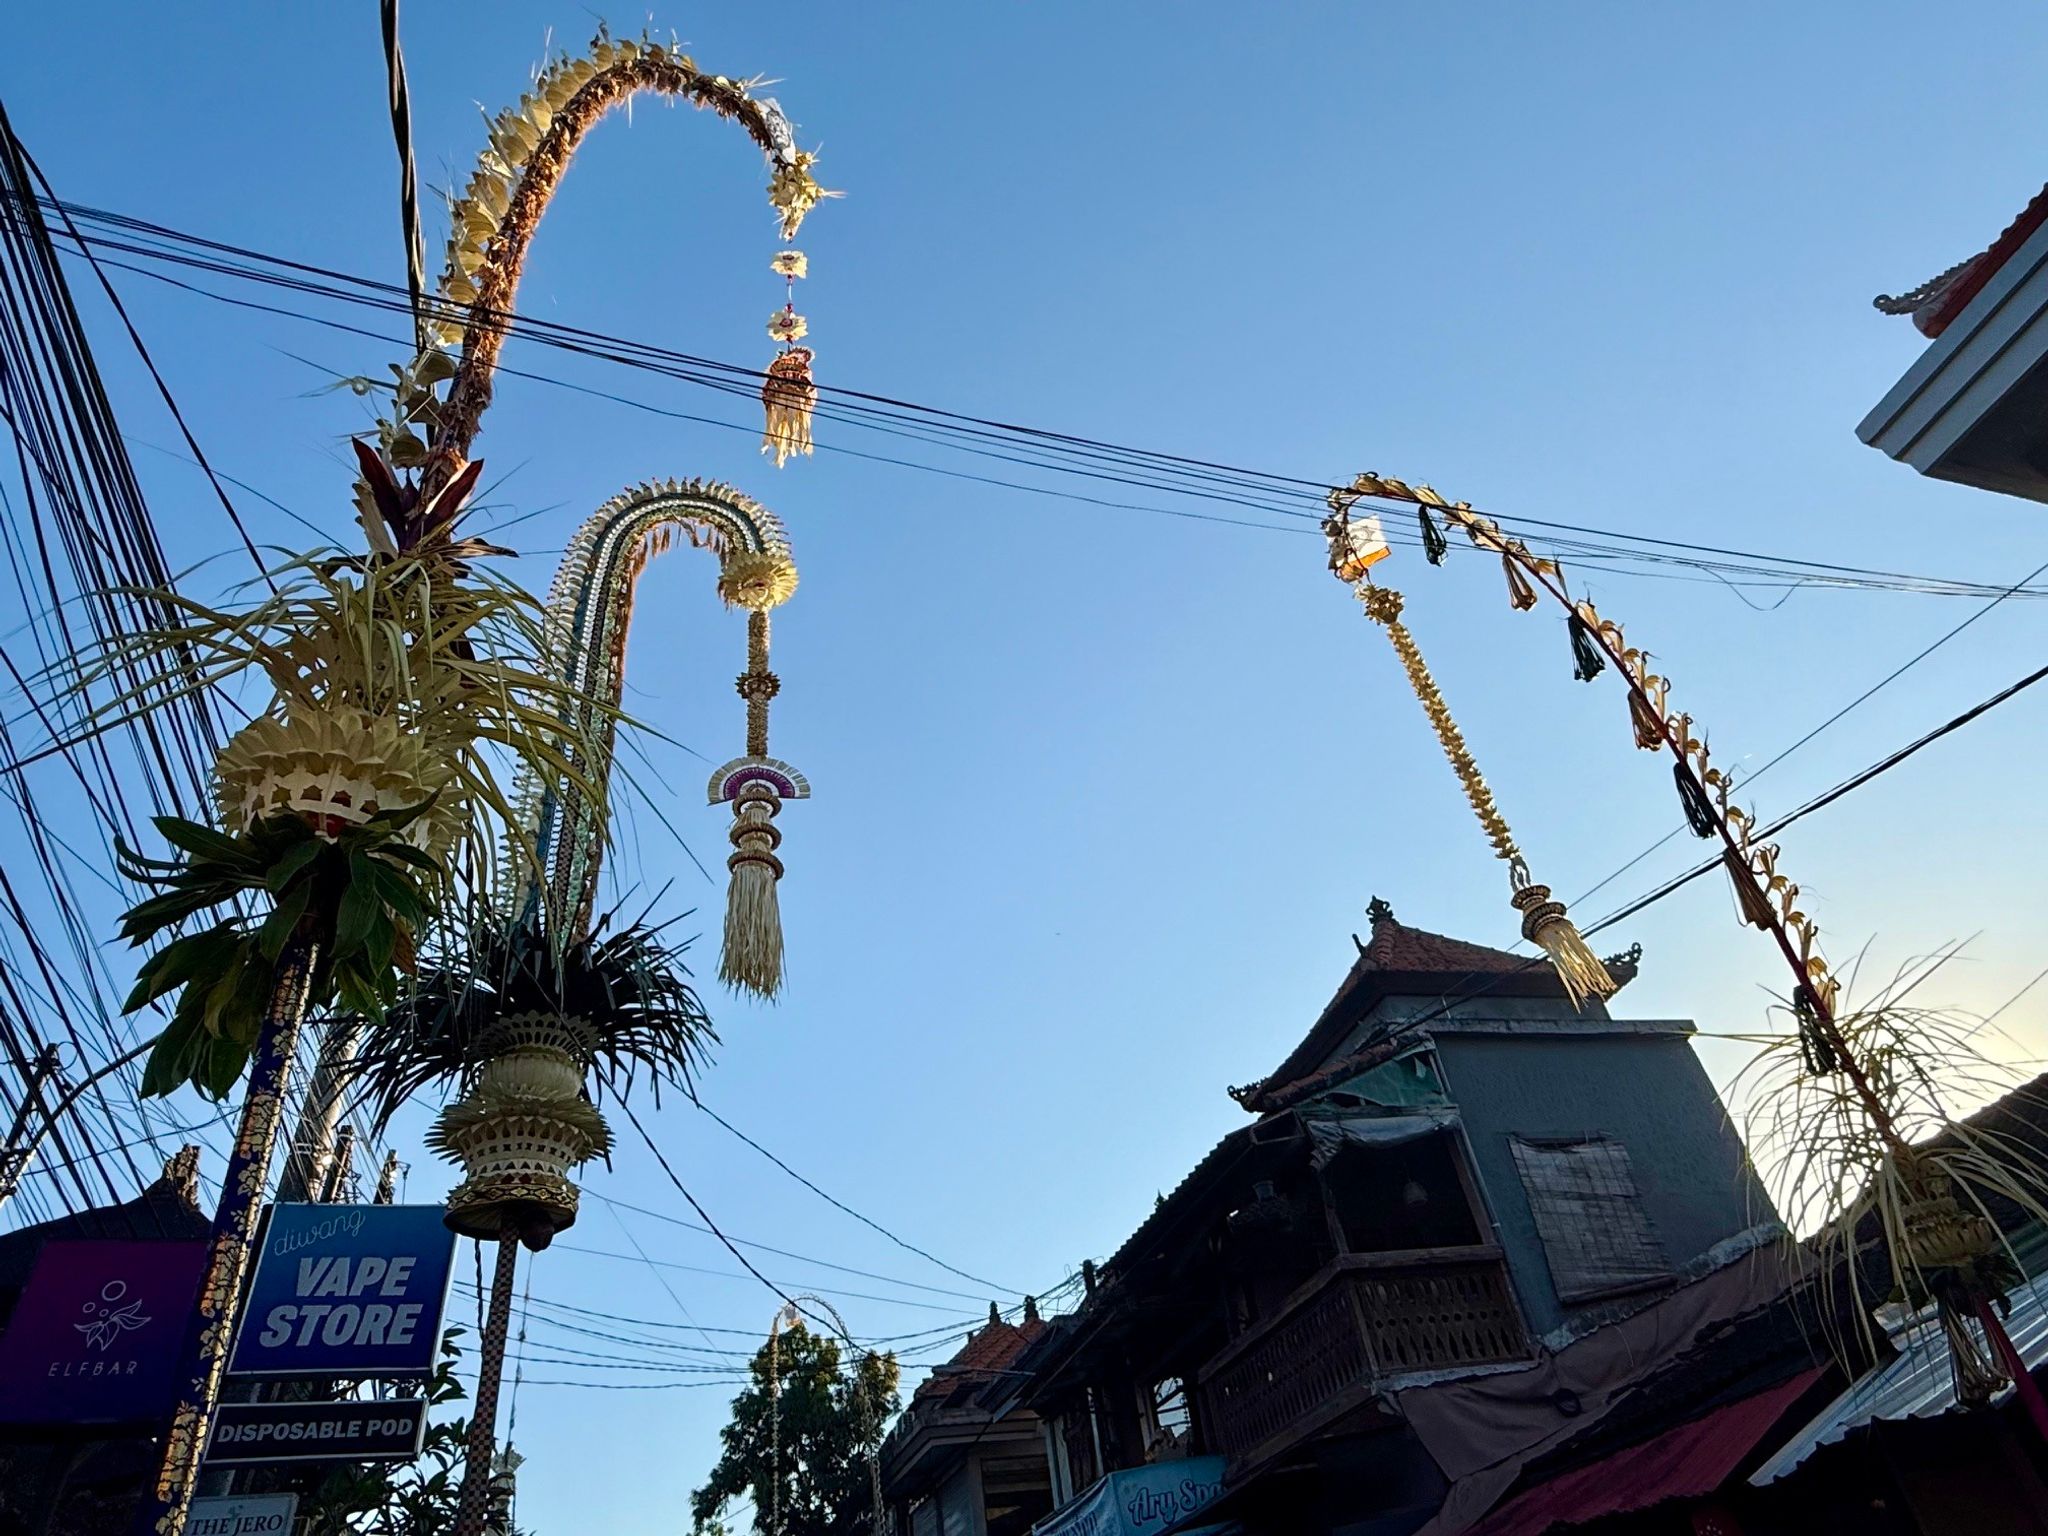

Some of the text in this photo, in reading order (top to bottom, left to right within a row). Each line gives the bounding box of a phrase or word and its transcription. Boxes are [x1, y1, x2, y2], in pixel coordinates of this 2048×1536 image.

[274, 1209, 366, 1257] diwang
[295, 1256, 417, 1297] VAPE
[259, 1303, 424, 1348] STORE
[47, 1360, 139, 1378] ELFBAR
[216, 1418, 413, 1443] DISPOSABLE POD
[189, 1514, 283, 1536] THE JERO
[1128, 1486, 1178, 1527] Ary
